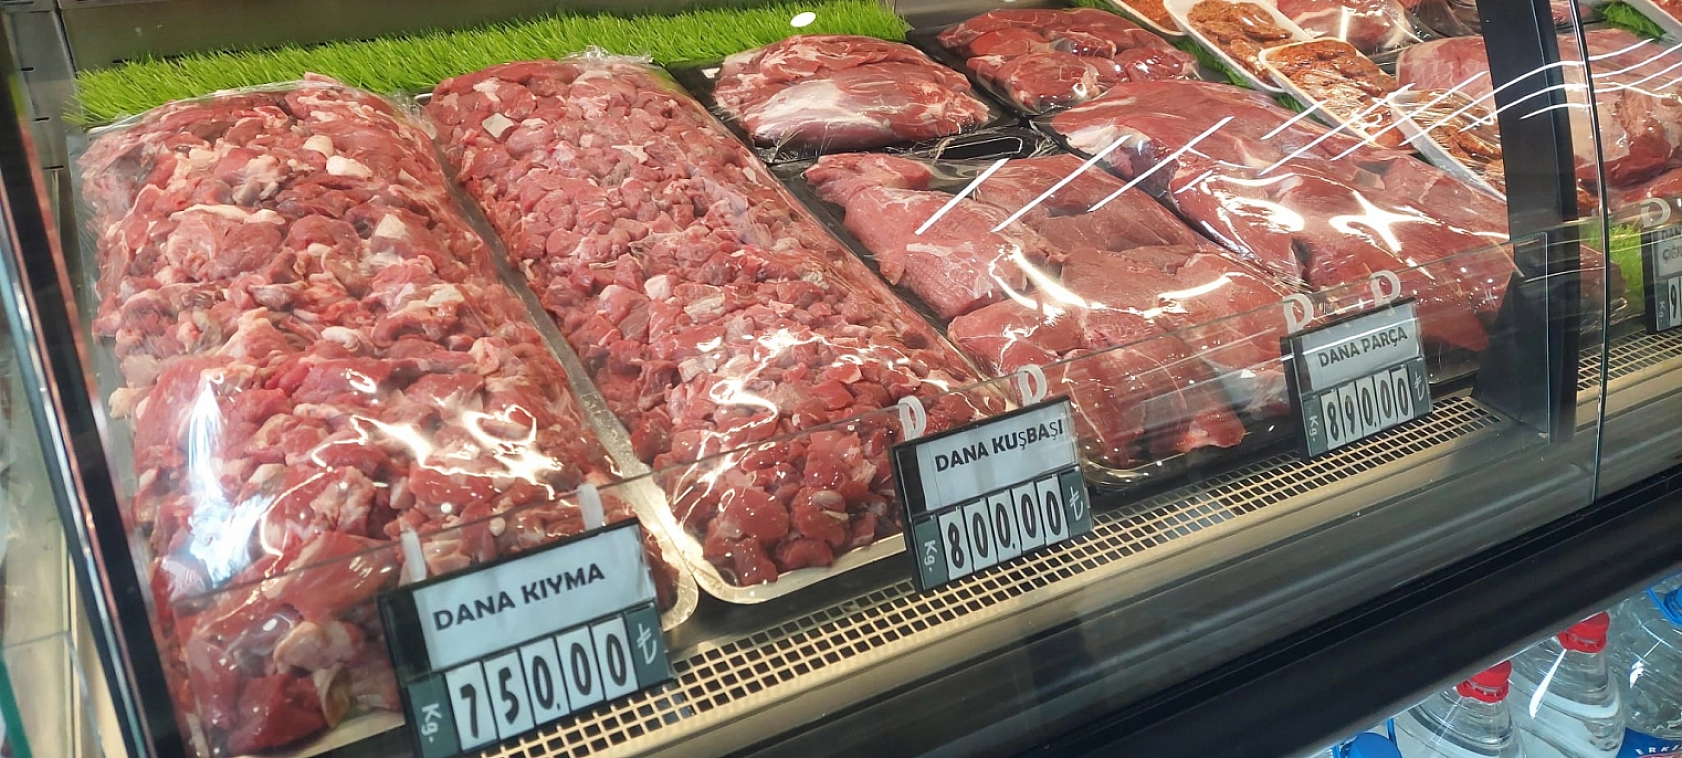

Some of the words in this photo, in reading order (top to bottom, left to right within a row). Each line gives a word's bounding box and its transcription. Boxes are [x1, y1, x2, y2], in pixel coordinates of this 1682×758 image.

[1317, 342, 1361, 368] DANA
[1361, 326, 1408, 353] PARÇA
[934, 441, 989, 472] DANA
[991, 419, 1064, 454] KUŞBAŞI
[924, 539, 938, 573] Kg.
[947, 490, 1062, 569] 800.00
[432, 590, 516, 632] DANA
[520, 562, 605, 605] KIYMA
[460, 633, 627, 739] 750.00
[421, 702, 440, 743] Kg.
